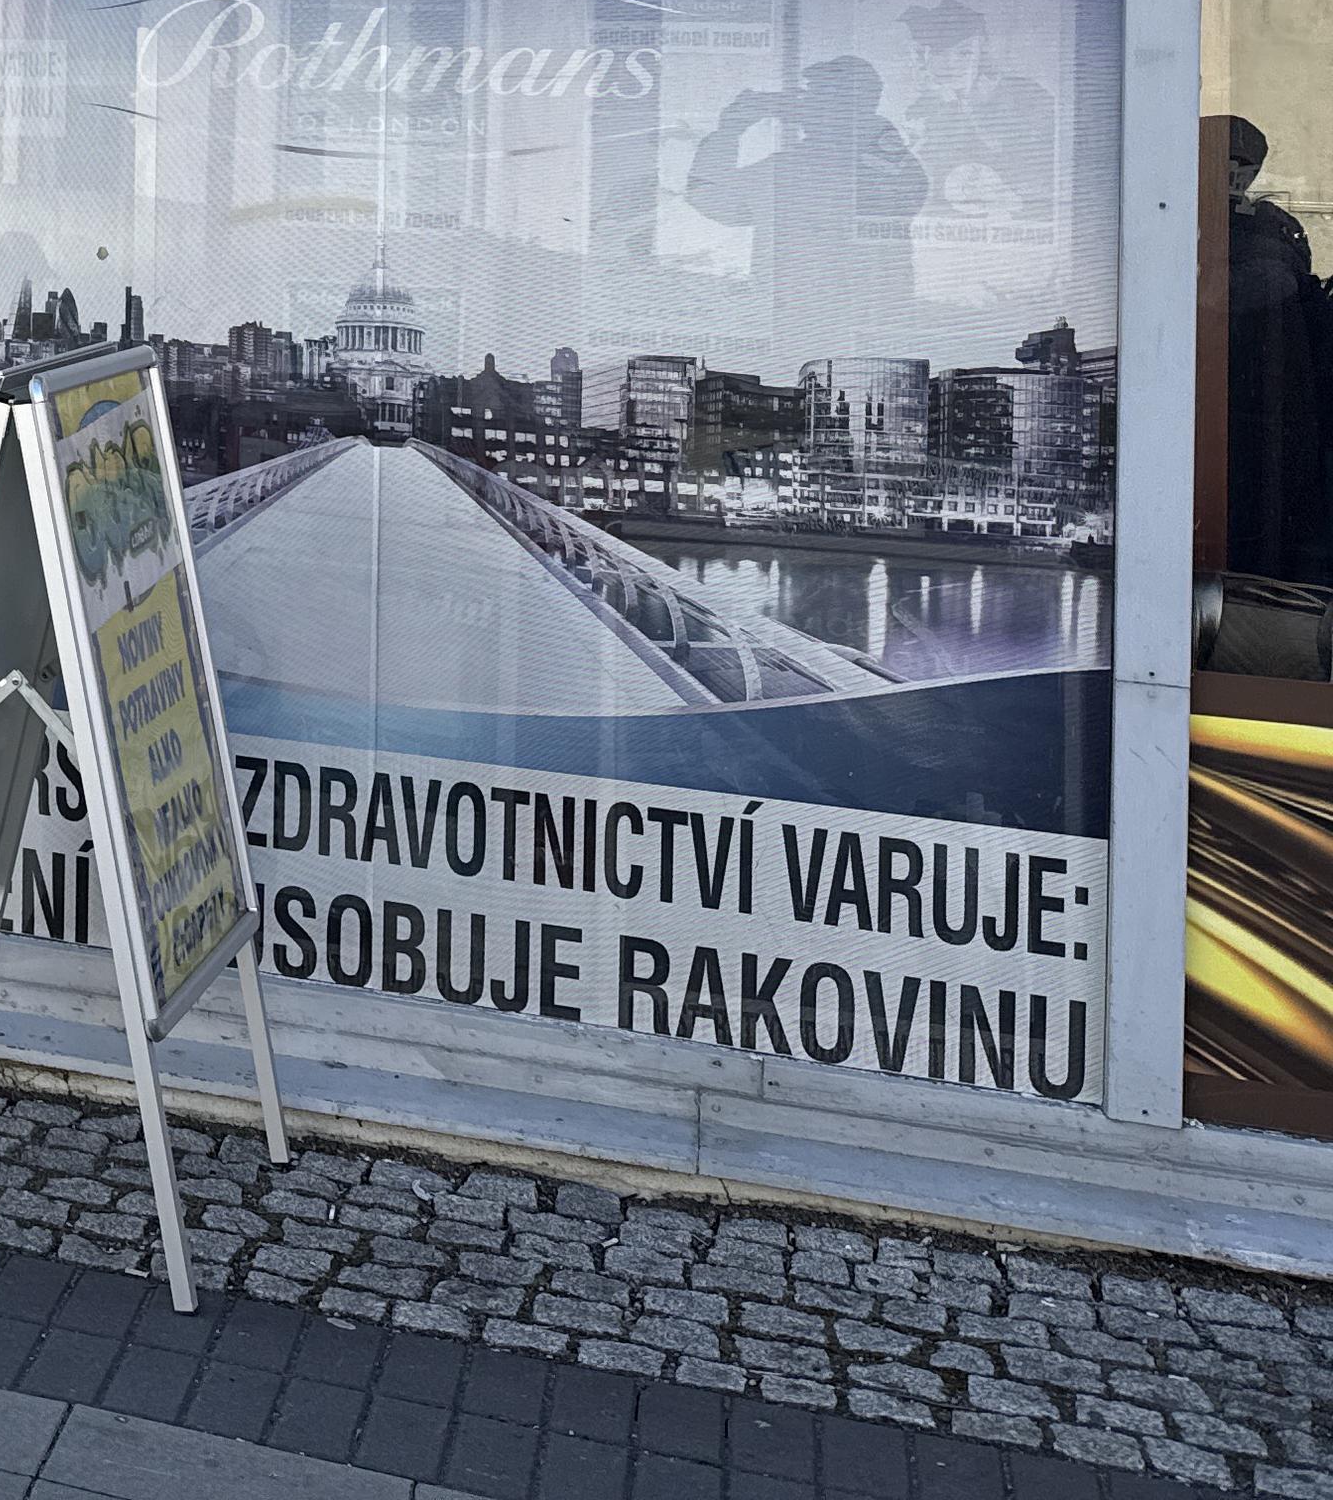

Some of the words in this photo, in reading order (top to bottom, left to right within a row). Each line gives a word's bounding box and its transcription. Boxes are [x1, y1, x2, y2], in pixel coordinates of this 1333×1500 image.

[116, 610, 166, 674] NOVINY
[118, 660, 186, 742] POTRAVINY
[148, 728, 183, 787] ALKO
[234, 755, 757, 915] ZDRAVOTNICTVÍ
[782, 823, 1091, 961] VARUJE:
[618, 933, 1089, 1102] RAKOVINU
